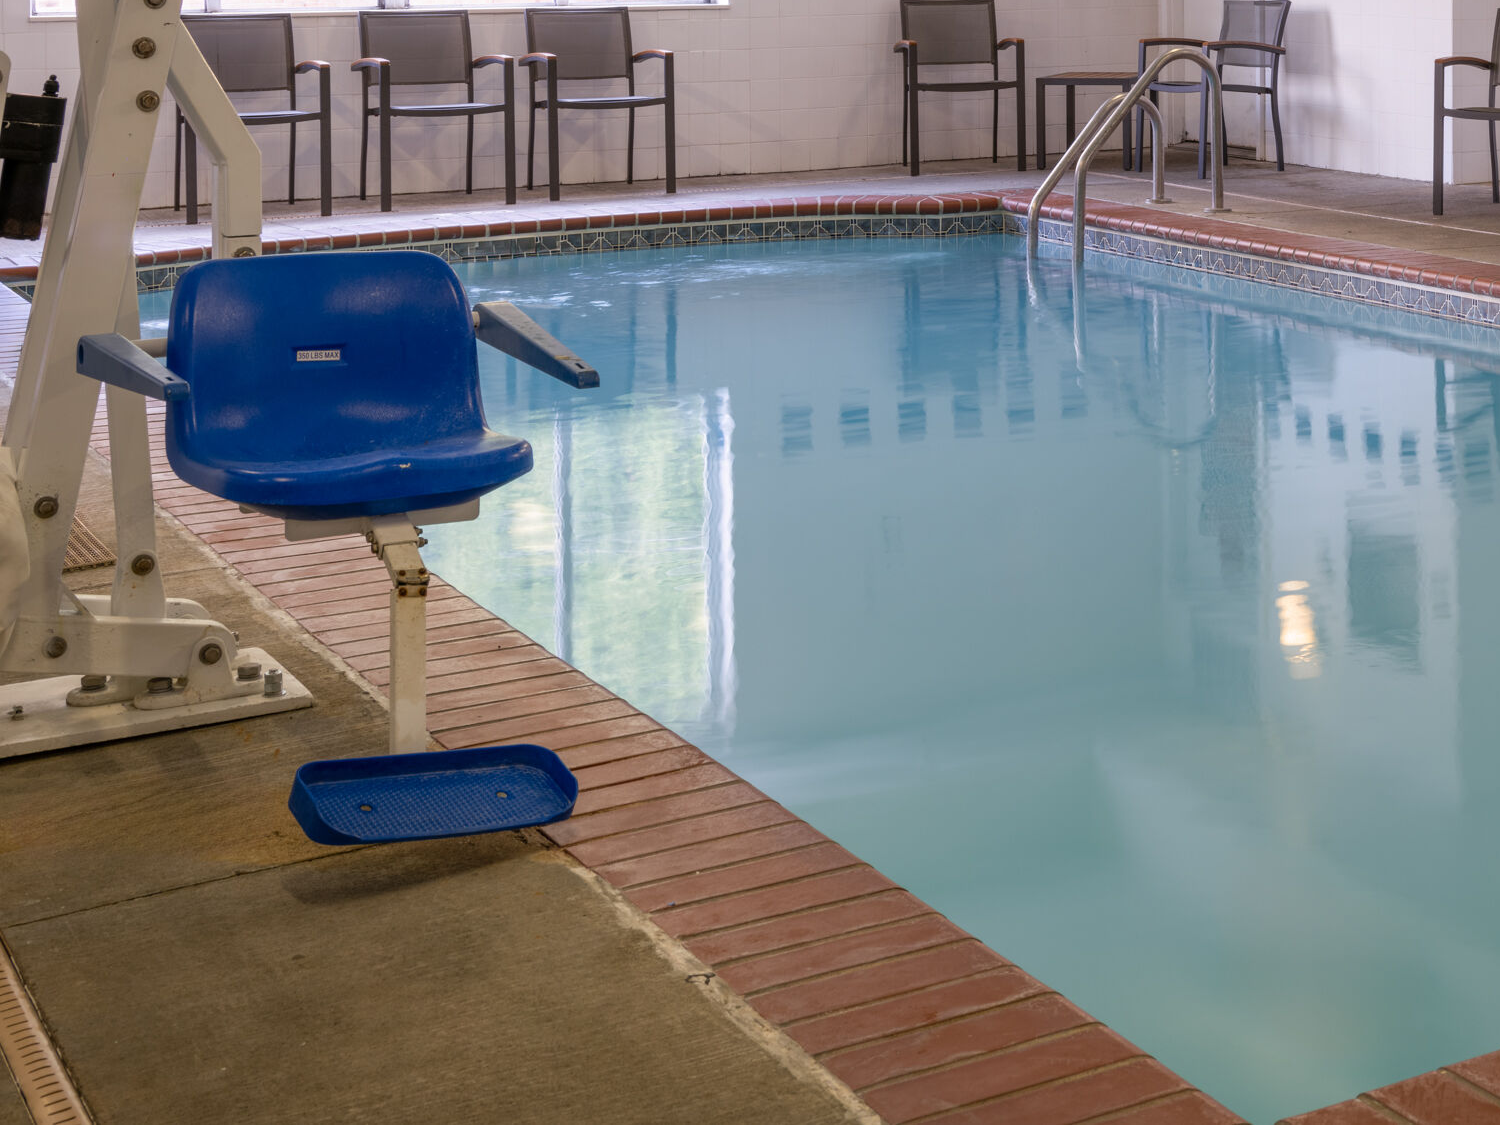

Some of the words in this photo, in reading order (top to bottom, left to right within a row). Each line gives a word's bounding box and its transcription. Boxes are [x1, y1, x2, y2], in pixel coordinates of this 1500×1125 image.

[298, 352, 310, 360] 350
[310, 351, 323, 359] LBS
[324, 351, 339, 359] MAX
